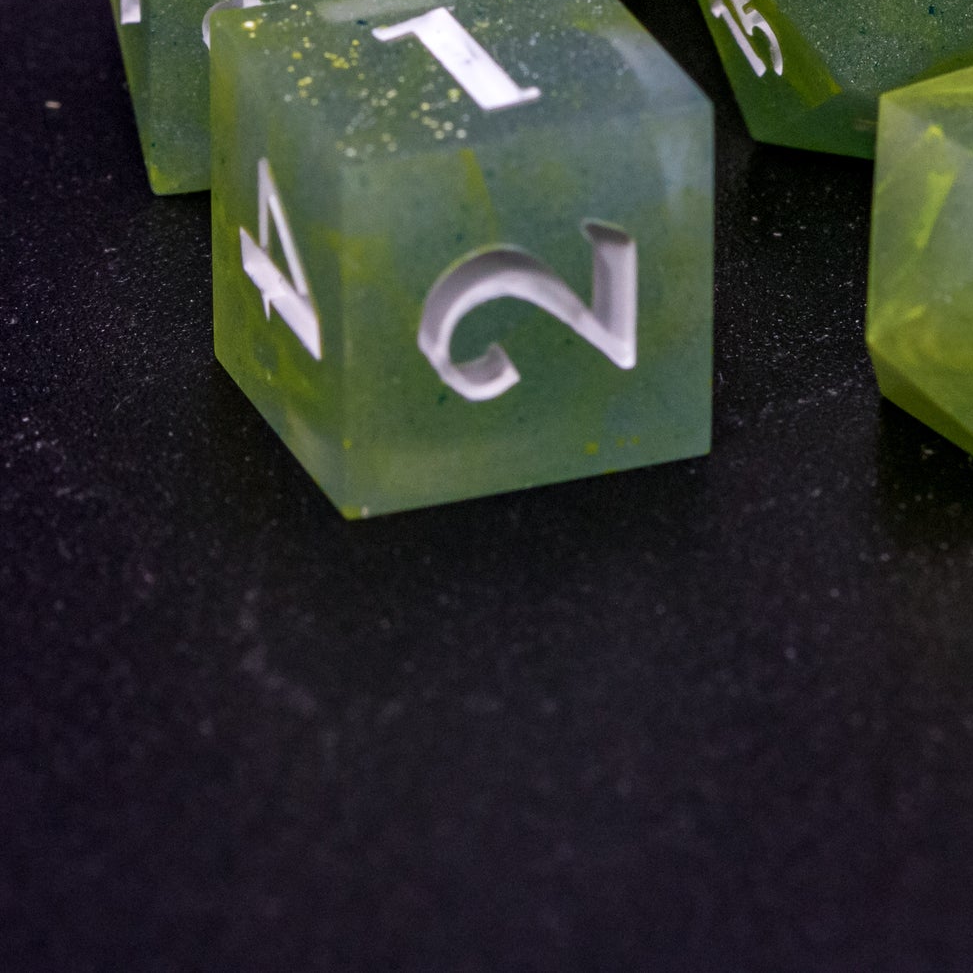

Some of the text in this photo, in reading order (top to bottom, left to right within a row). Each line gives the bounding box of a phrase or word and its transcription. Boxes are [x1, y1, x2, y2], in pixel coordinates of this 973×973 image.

[371, 6, 542, 111] 1
[239, 158, 323, 361] 4
[417, 217, 638, 402] 2
